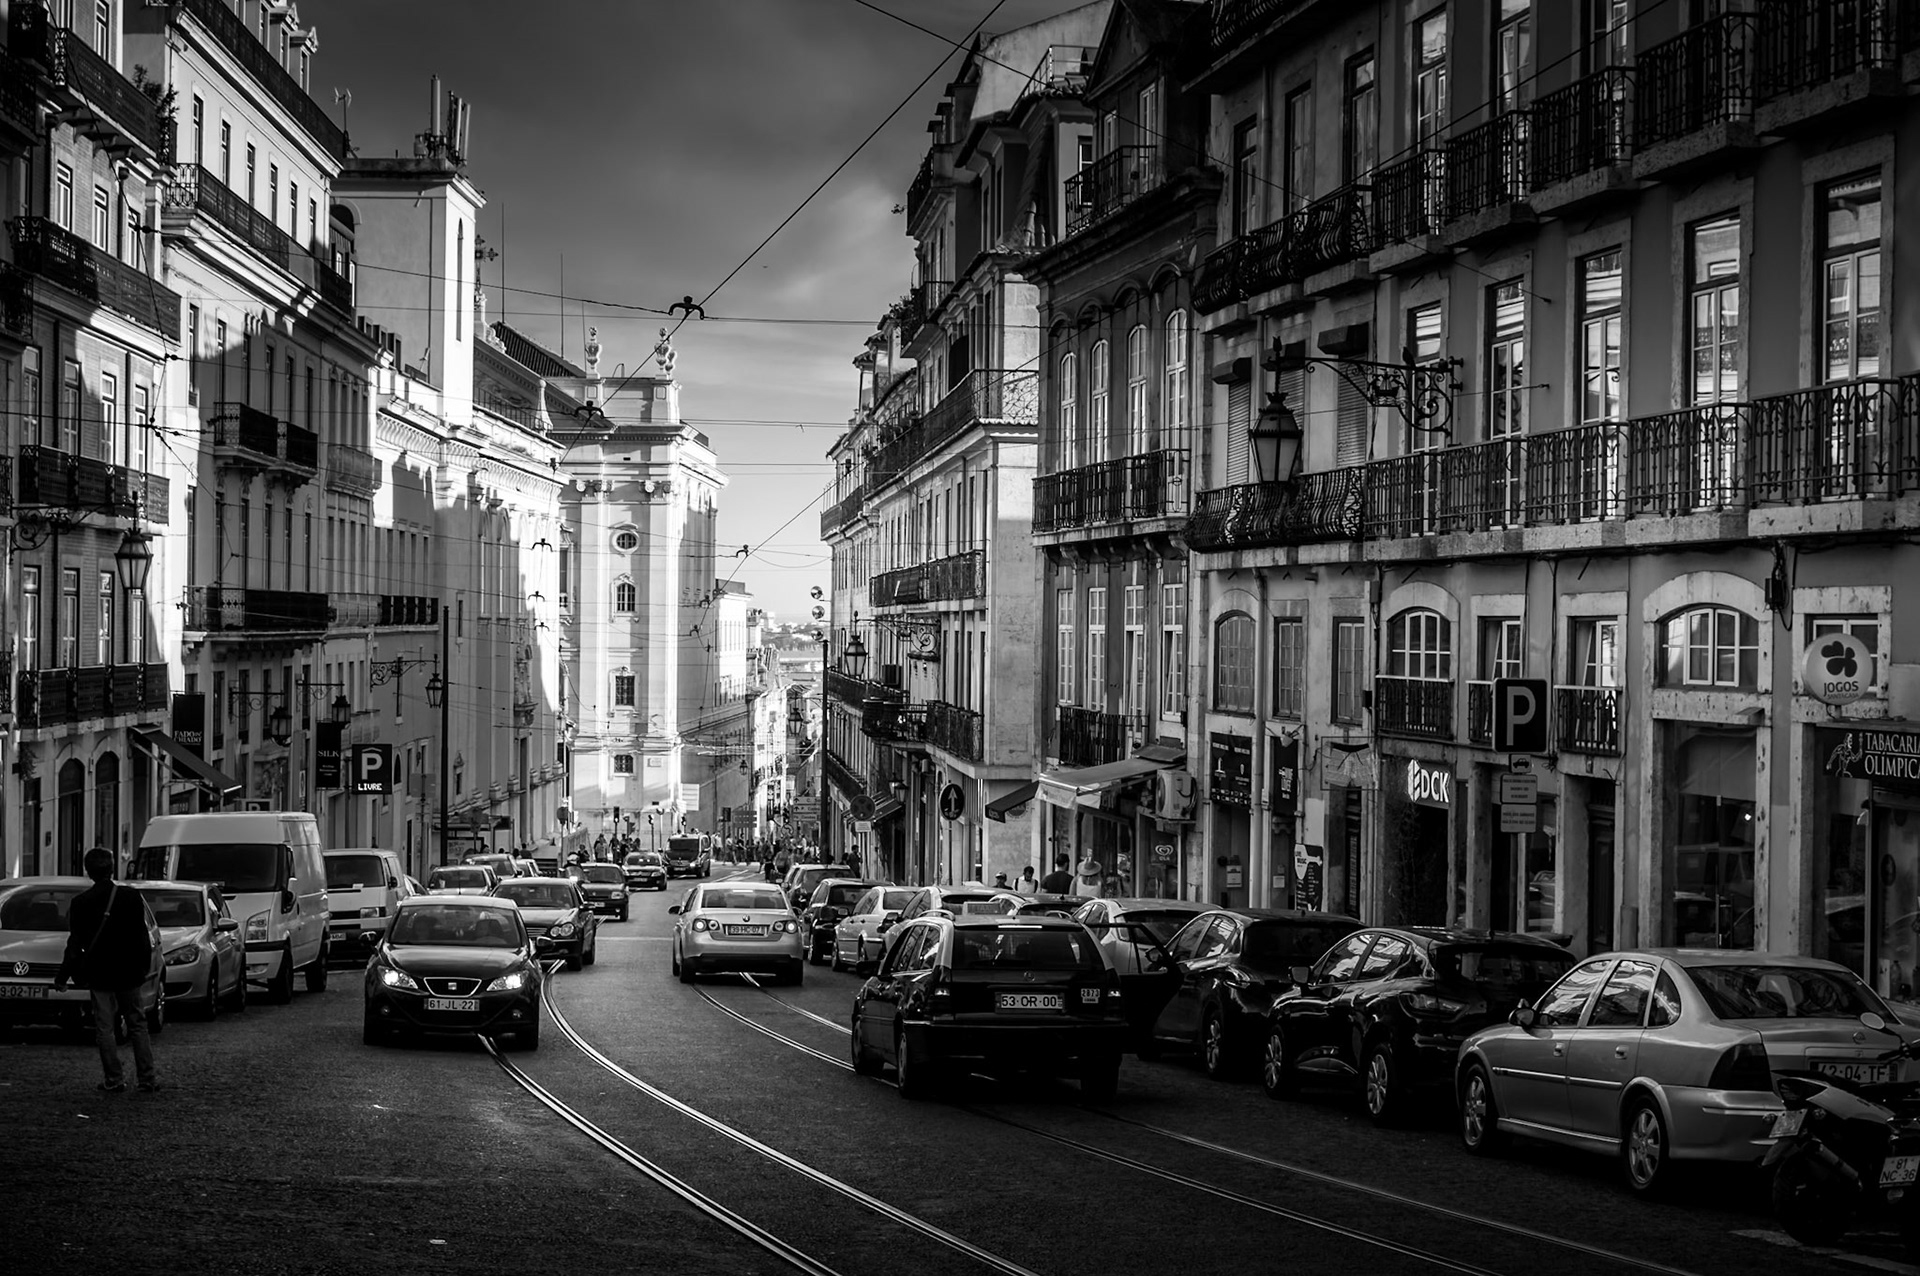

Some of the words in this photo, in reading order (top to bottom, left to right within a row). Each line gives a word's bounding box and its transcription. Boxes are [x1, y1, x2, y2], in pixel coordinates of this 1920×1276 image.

[1823, 680, 1859, 697] JOGOS
[1506, 686, 1537, 746] P
[317, 750, 340, 758] SILK
[361, 752, 383, 780] P
[357, 782, 383, 791] LIVRE
